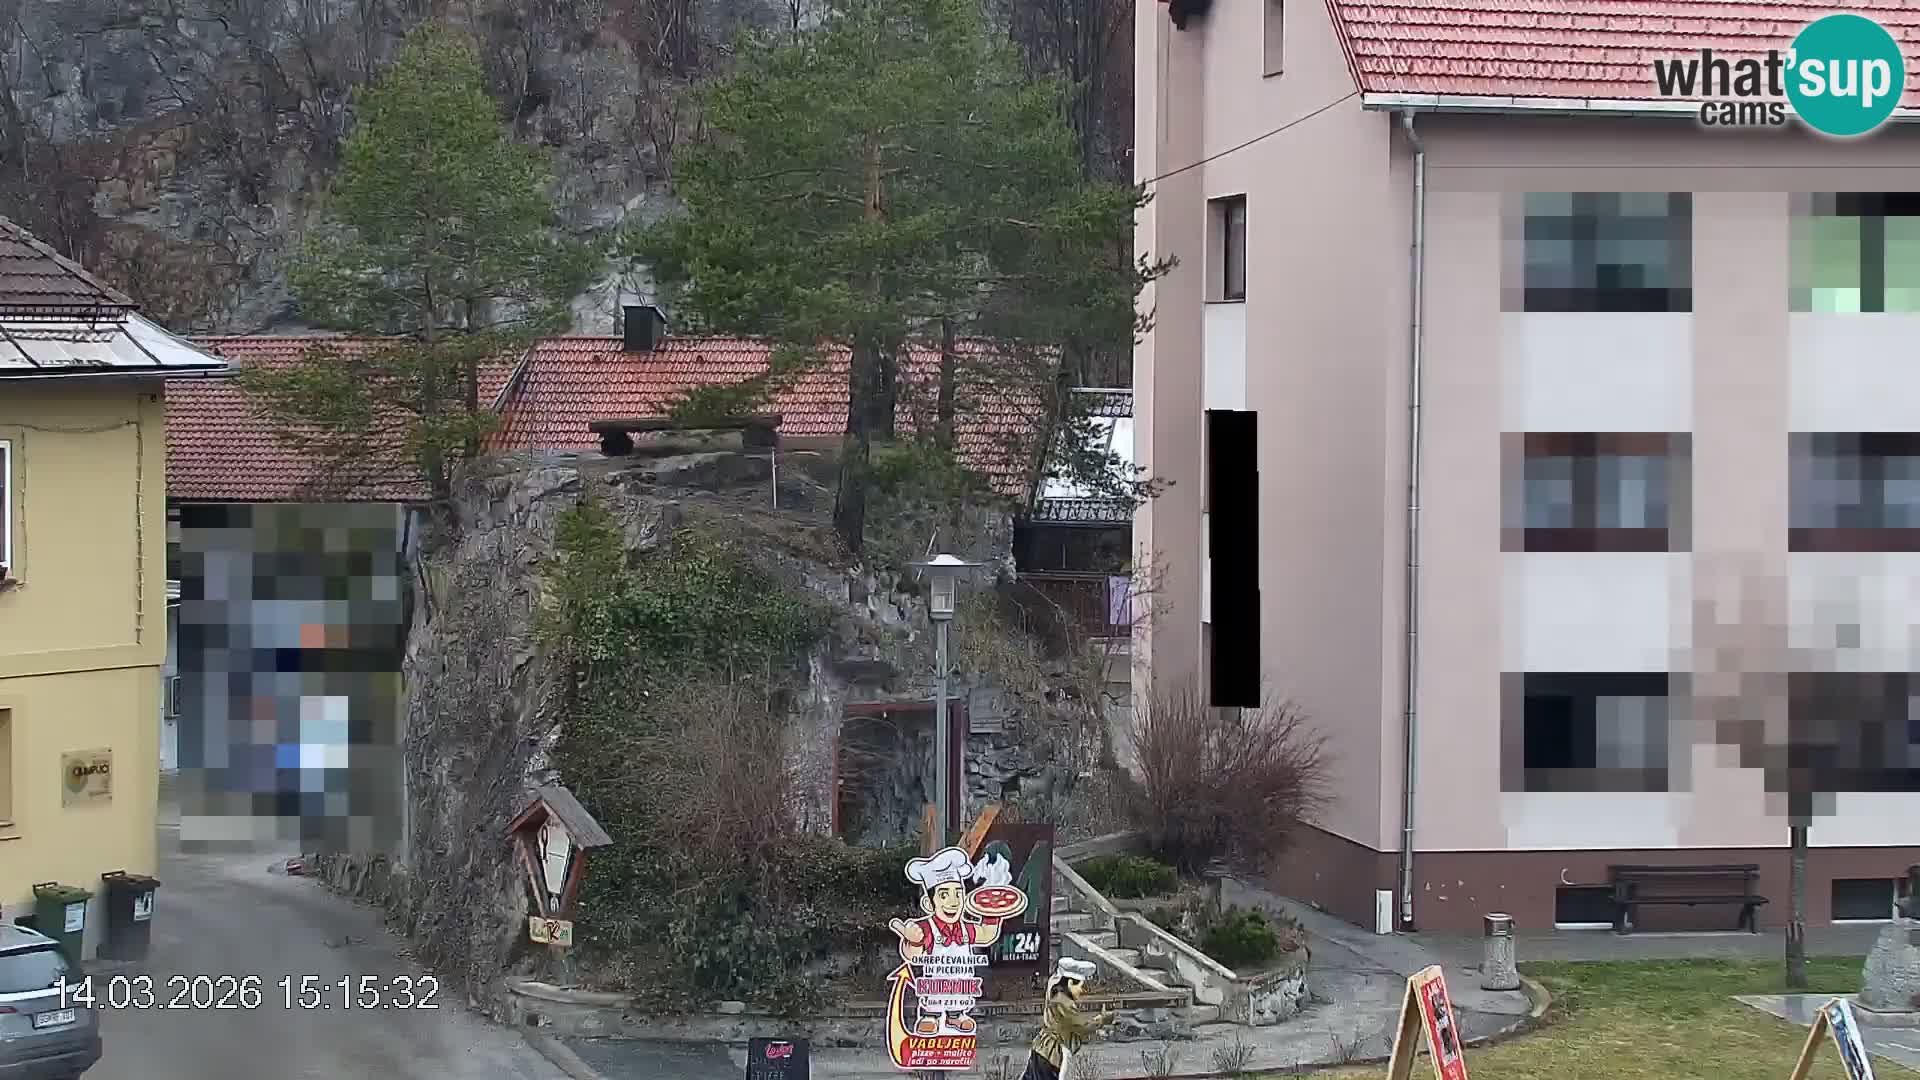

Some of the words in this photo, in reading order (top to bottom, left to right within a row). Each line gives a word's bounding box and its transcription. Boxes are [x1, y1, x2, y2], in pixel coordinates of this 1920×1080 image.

[925, 965, 934, 974] IN
[936, 965, 974, 974] PICERIJA
[909, 1038, 976, 1049] VABLJENI
